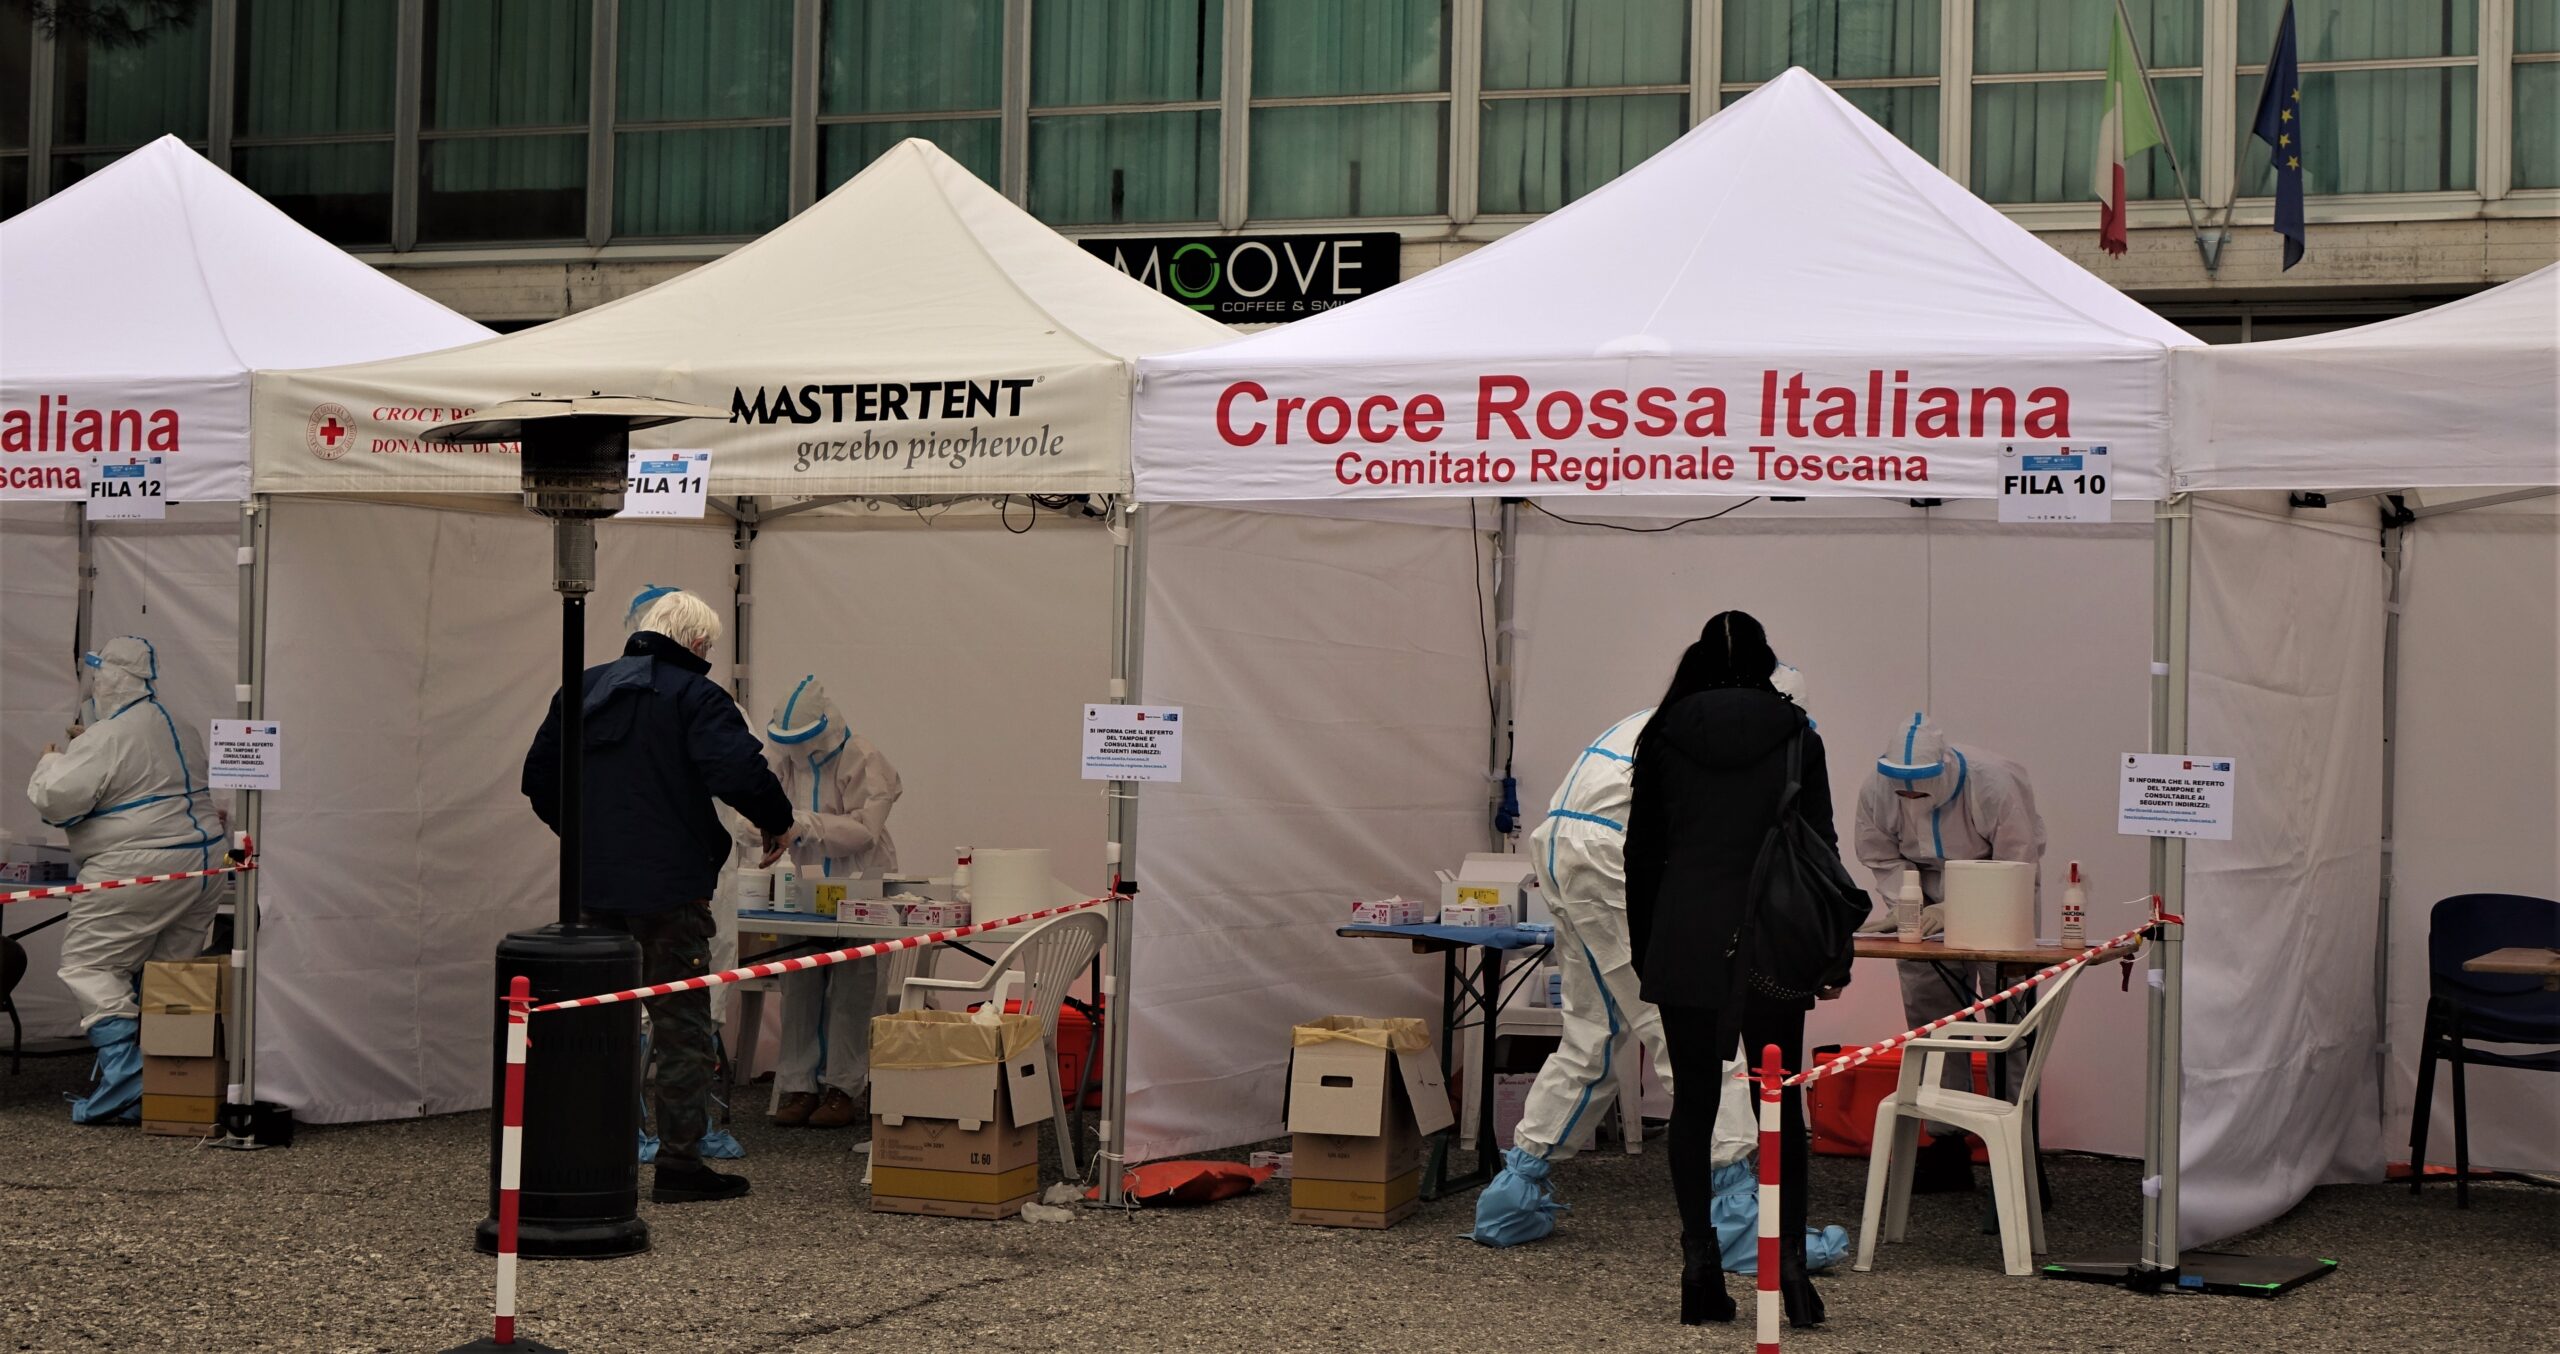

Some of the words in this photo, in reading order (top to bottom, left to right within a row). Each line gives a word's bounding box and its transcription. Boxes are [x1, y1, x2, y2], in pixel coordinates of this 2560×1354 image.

[1113, 241, 1362, 298] MOOVE
[1222, 301, 1286, 312] COFFEE
[1292, 301, 1305, 312] &
[372, 407, 444, 422] CROCE
[1215, 380, 1446, 448] Croce
[1475, 374, 1728, 442] Rossa
[1759, 369, 2071, 440] Italiana
[0, 394, 180, 454] aliana
[371, 439, 464, 454] DONATORI
[472, 442, 490, 454] DI
[793, 429, 899, 472] gazebo
[903, 424, 1065, 470] pieghevole
[1334, 450, 1517, 486] Comitato
[1529, 446, 1736, 492] Regionale
[1748, 444, 1928, 482] Toscana
[91, 481, 132, 498] FILA
[138, 480, 161, 497] 12
[678, 477, 701, 494] 11
[2004, 475, 2064, 495] FILA
[2074, 474, 2106, 494] 10
